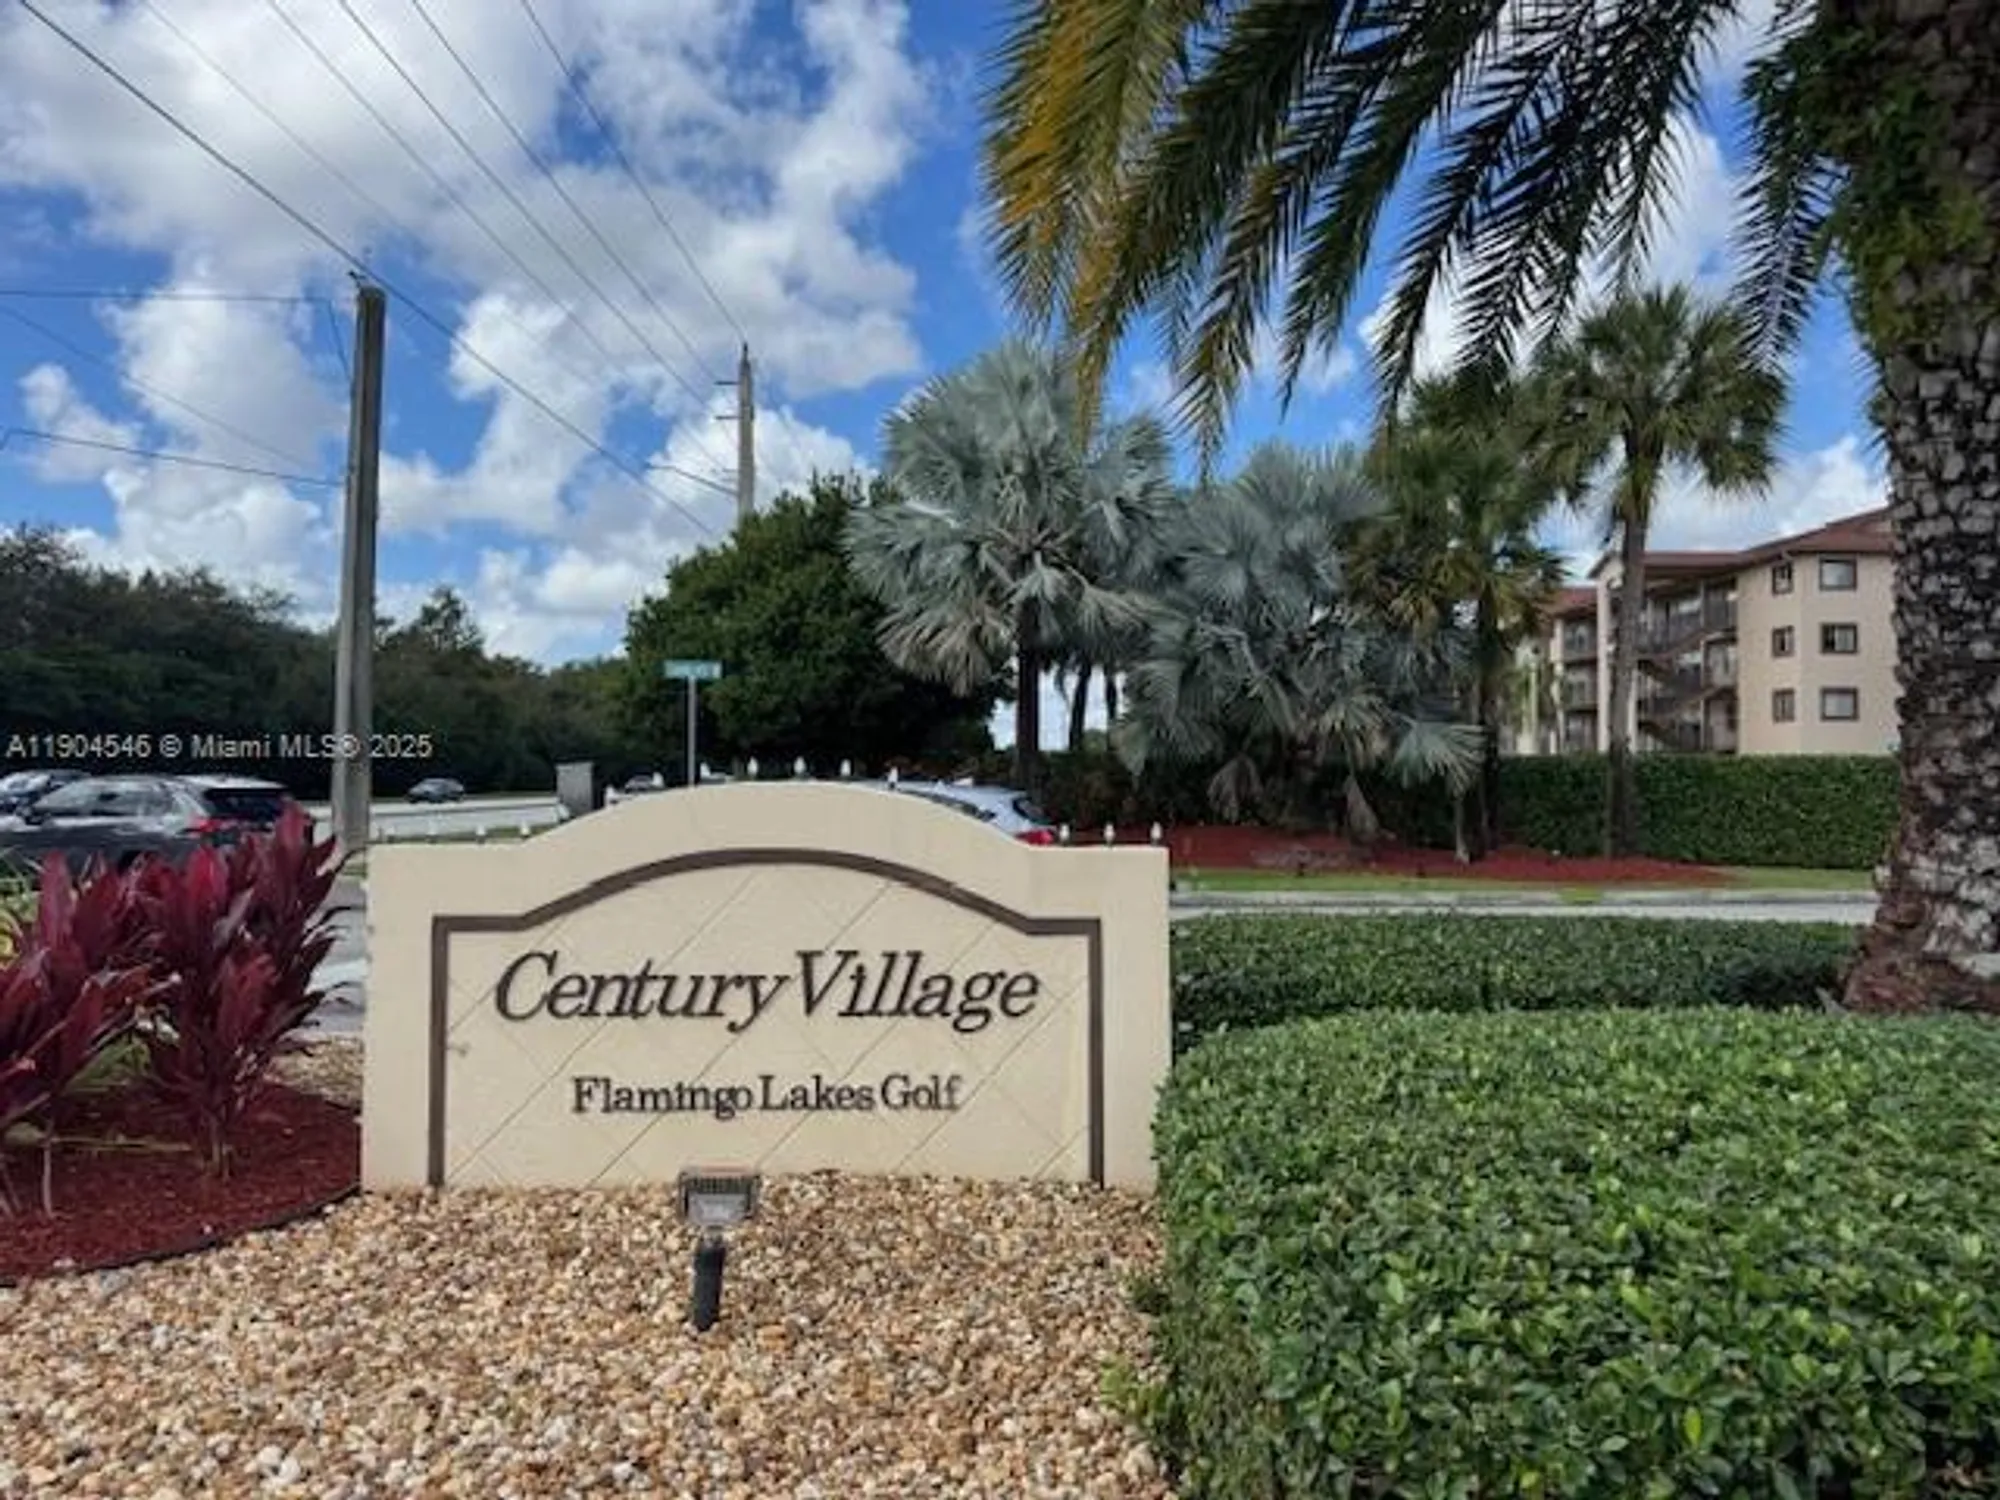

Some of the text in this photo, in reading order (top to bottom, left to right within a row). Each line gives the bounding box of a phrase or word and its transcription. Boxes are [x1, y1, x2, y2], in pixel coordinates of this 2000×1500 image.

[495, 950, 1040, 1032] Century Village
[571, 1074, 962, 1120] Flamingo Lakes Golf
